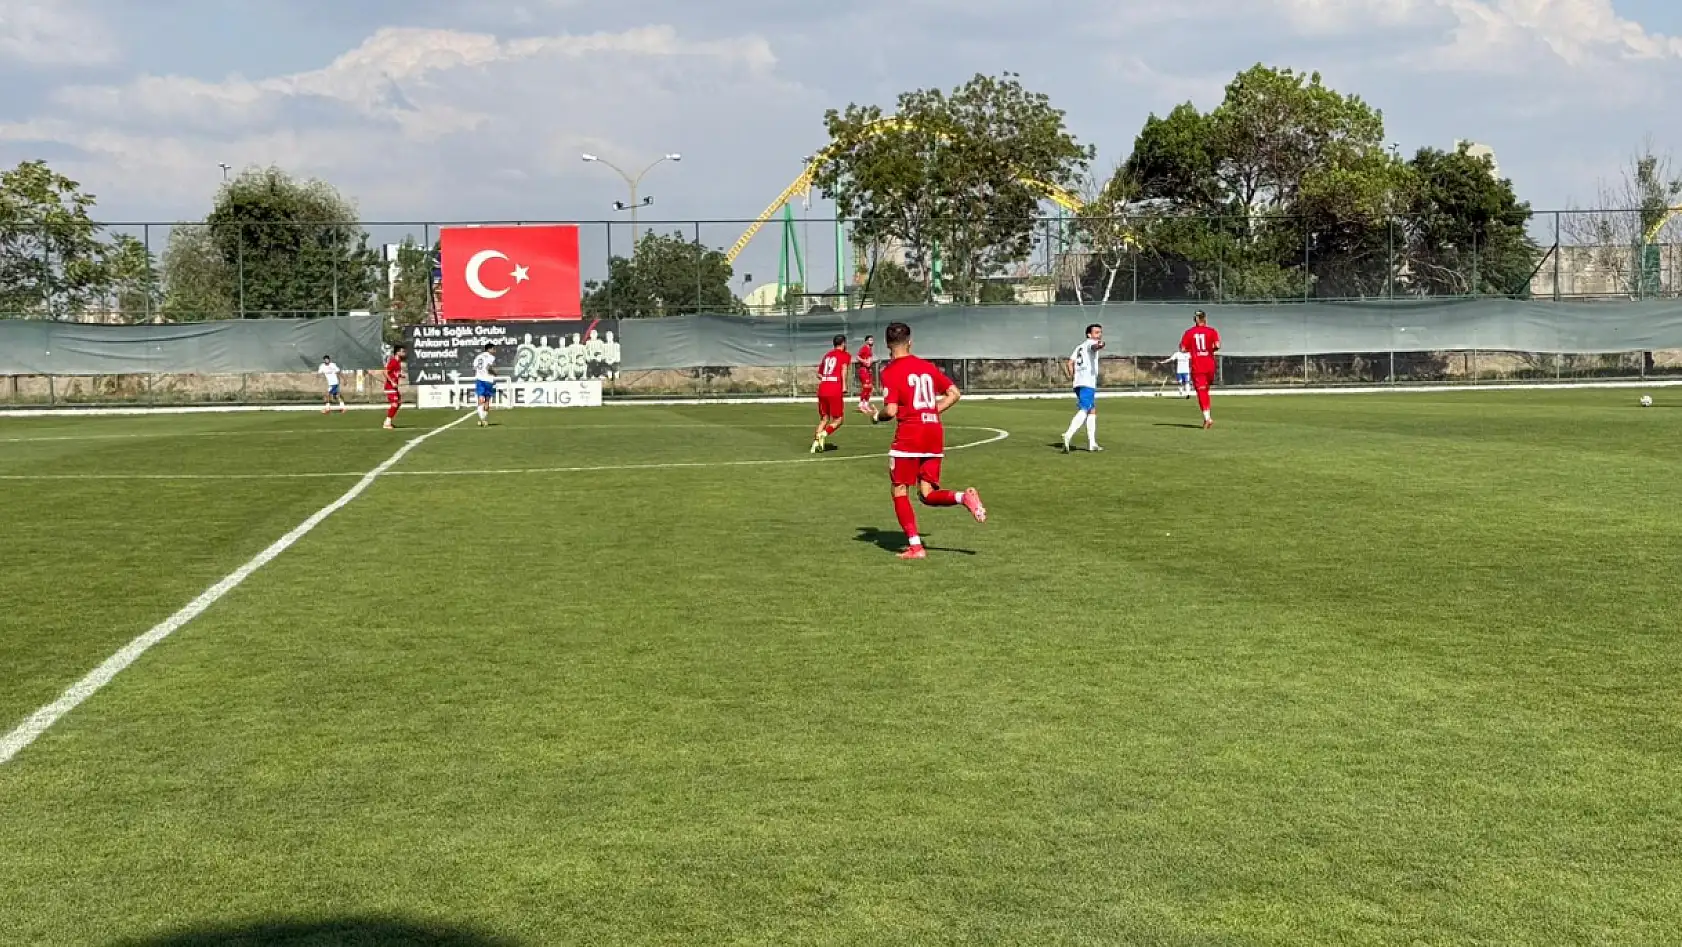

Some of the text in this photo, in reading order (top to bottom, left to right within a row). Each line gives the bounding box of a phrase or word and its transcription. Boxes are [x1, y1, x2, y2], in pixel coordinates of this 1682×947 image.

[413, 326, 422, 337] A
[423, 326, 441, 337] Life
[475, 325, 507, 335] Grubu
[414, 337, 450, 348] Ankara
[1193, 333, 1207, 350] 11
[823, 356, 838, 375] 19
[908, 373, 936, 411] 20
